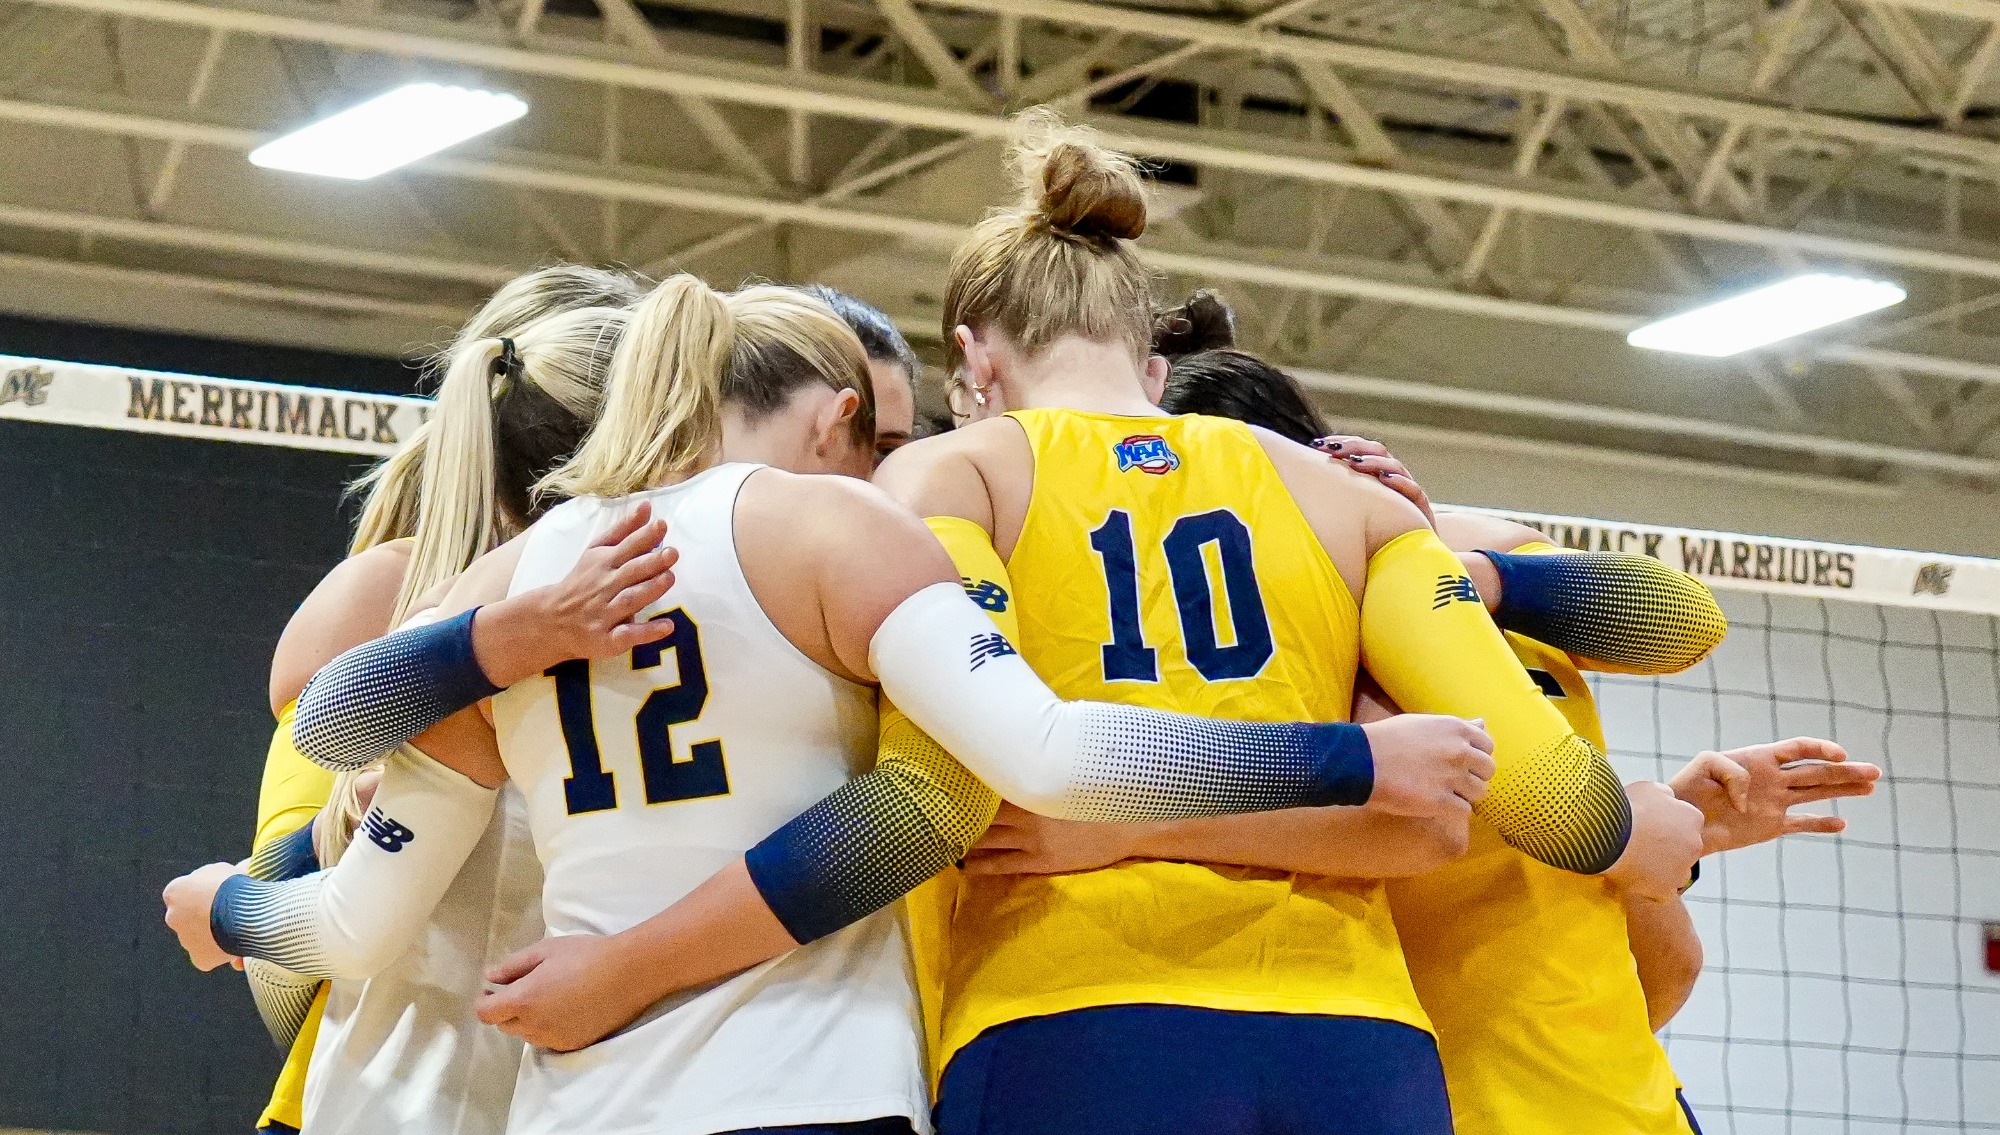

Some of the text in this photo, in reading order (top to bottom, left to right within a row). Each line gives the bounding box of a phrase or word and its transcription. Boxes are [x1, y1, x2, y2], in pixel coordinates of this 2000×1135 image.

[127, 376, 399, 443] MERRIMACK
[1089, 508, 1275, 683] 10
[1679, 535, 1855, 588] WARRIORS
[541, 604, 731, 816] 12
